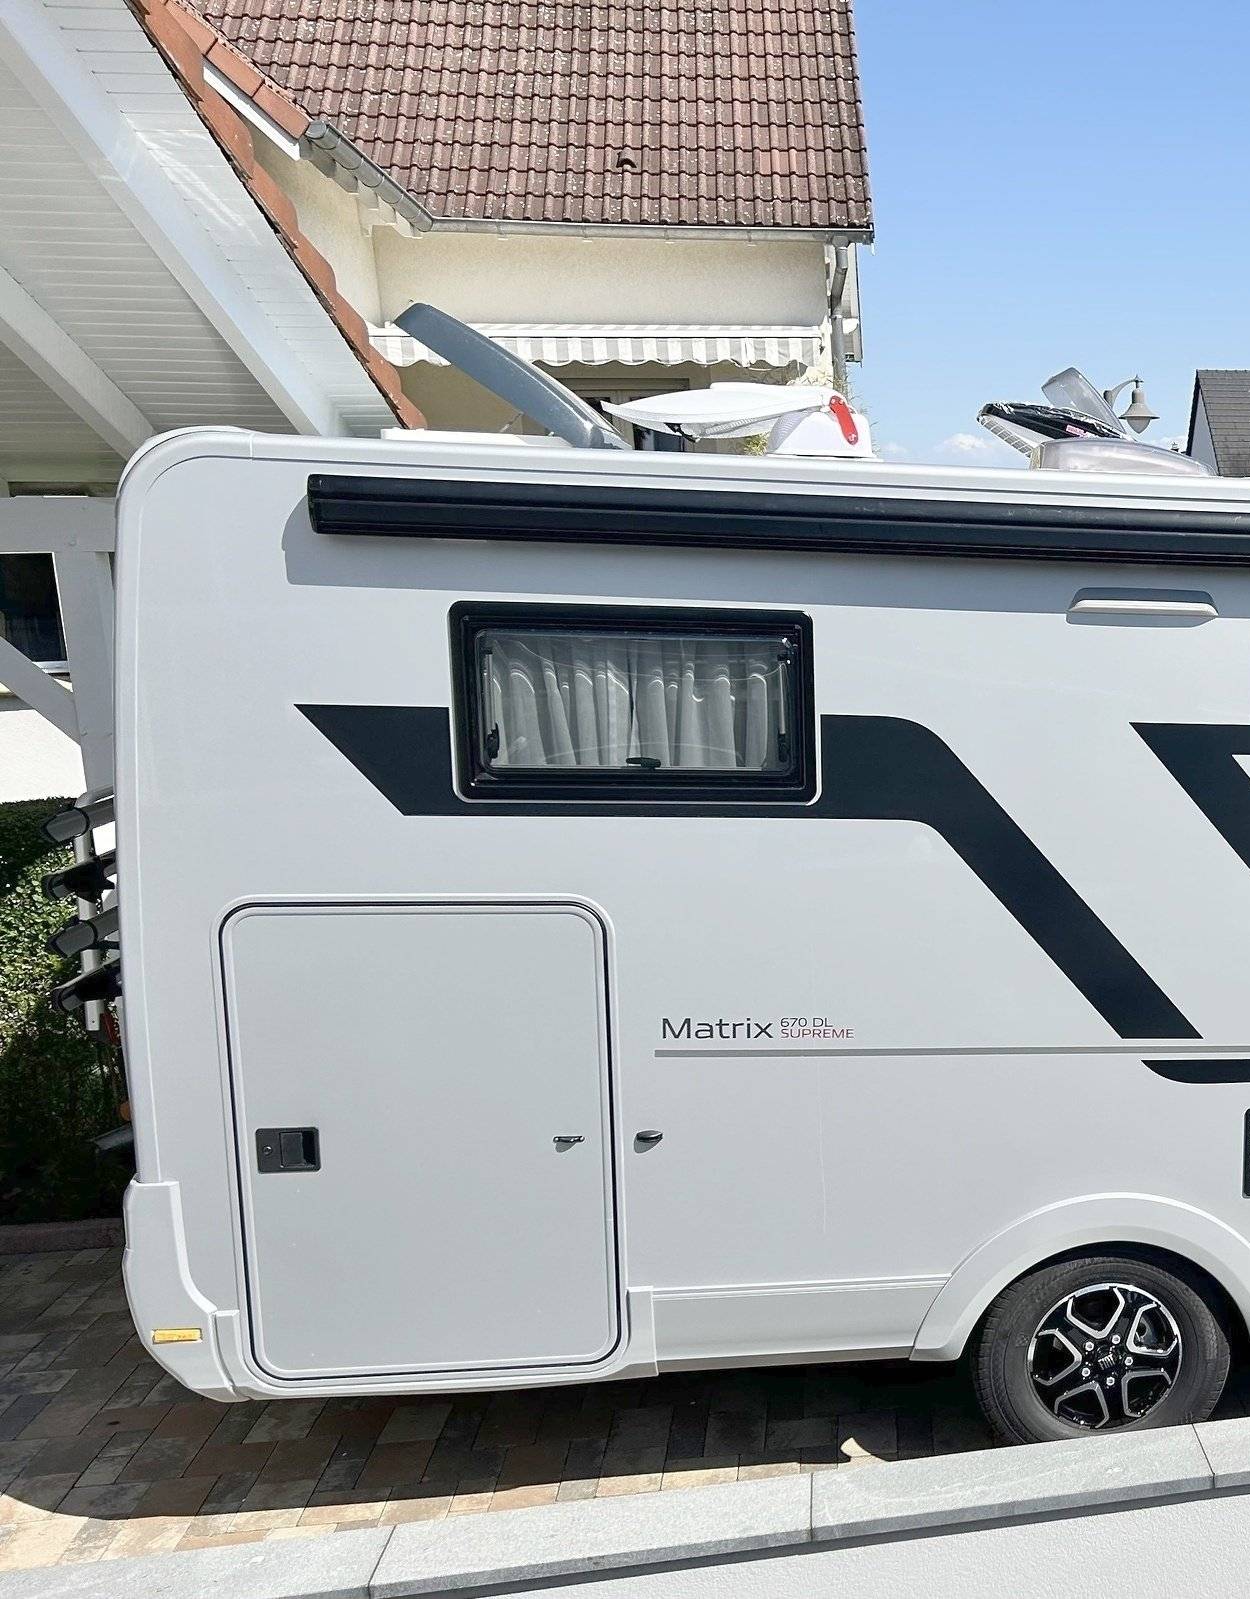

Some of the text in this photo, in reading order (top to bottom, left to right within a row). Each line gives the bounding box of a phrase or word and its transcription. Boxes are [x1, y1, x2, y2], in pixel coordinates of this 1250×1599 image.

[662, 1017, 774, 1039] Matrix
[780, 1017, 834, 1028] 670 DL
[780, 1028, 855, 1039] SUPREME
